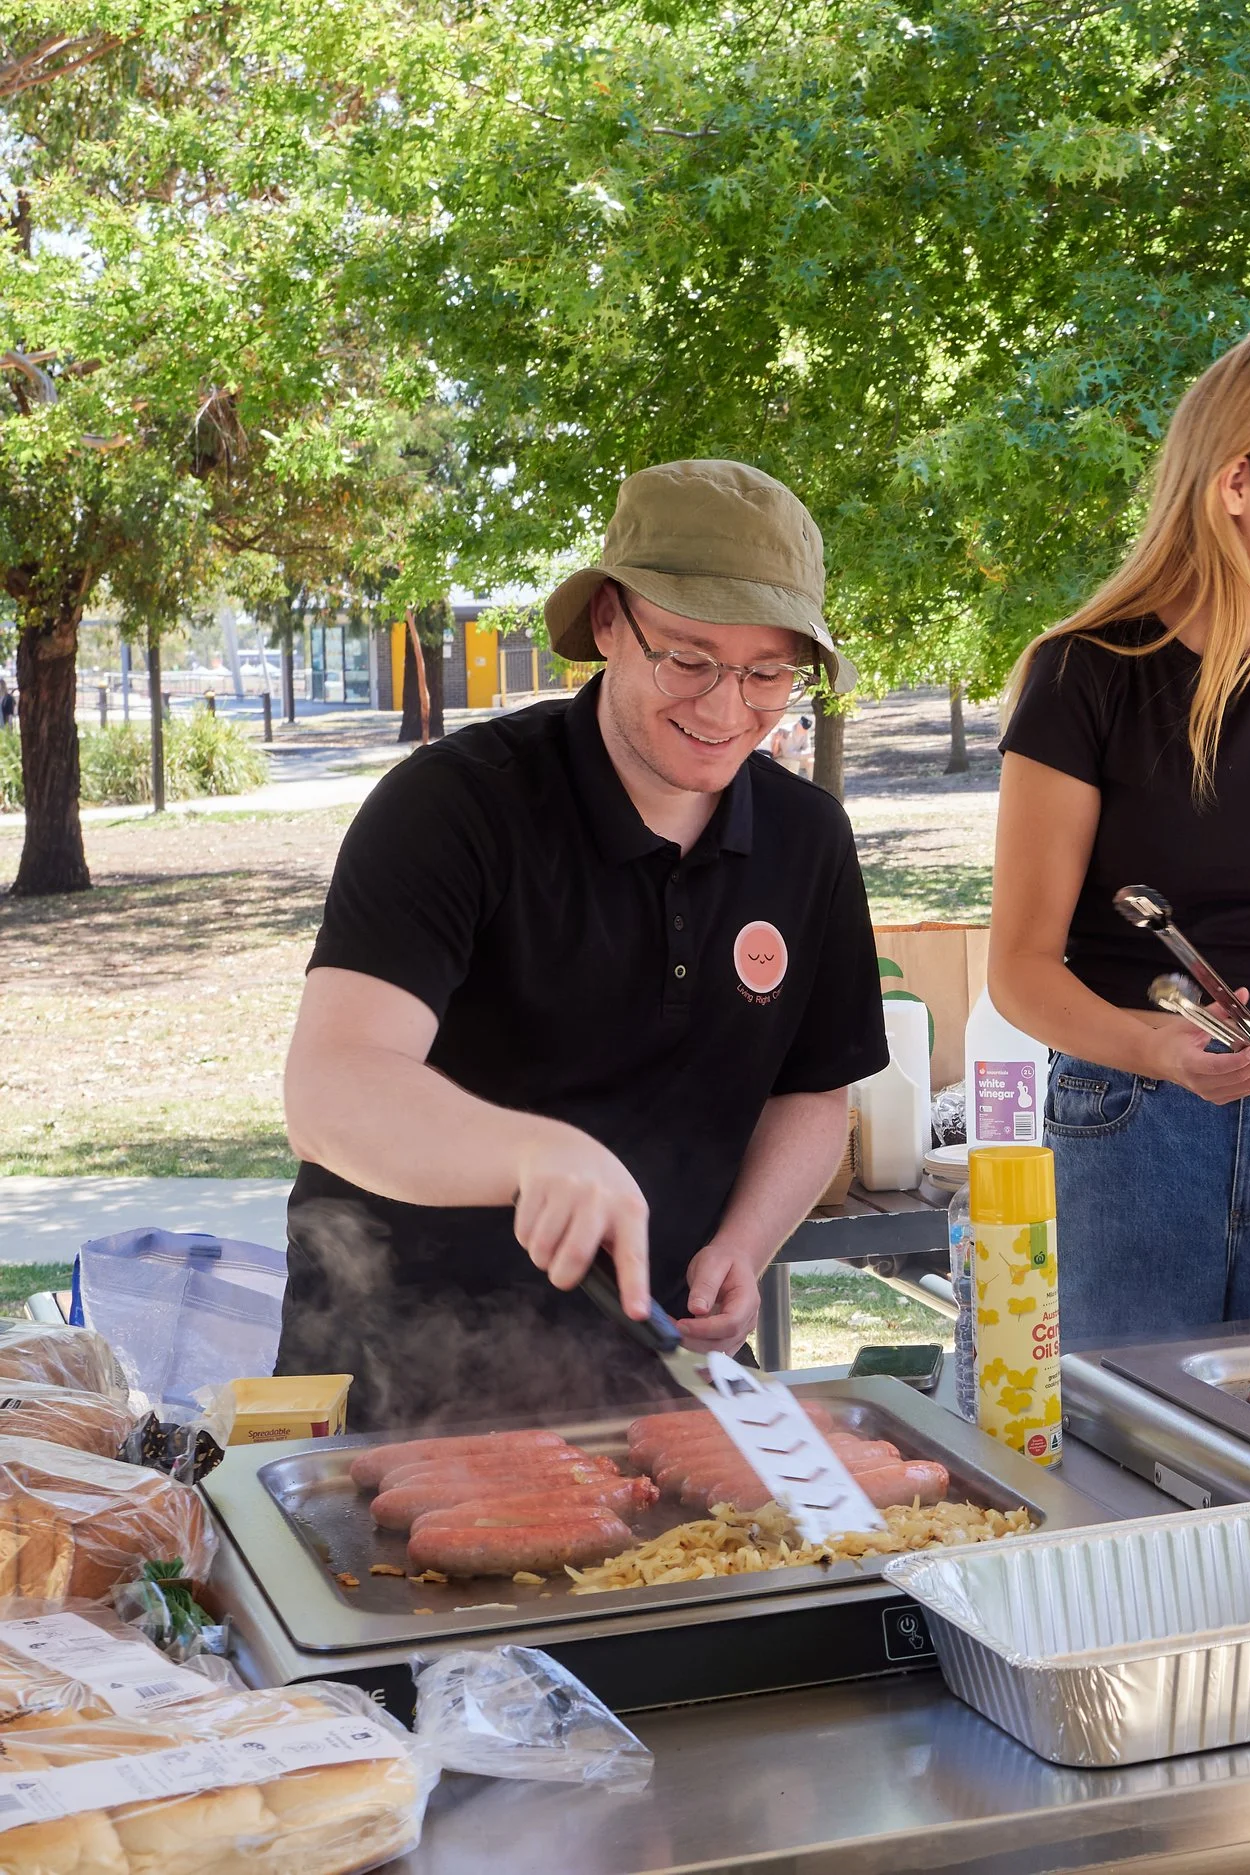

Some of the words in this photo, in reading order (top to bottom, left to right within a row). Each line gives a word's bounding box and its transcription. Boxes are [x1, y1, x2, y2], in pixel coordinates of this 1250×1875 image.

[978, 1078, 1006, 1088] white
[978, 1088, 1015, 1101] vinegar
[1032, 1343, 1053, 1361] Oil
[248, 1428, 291, 1439] Spreadable
